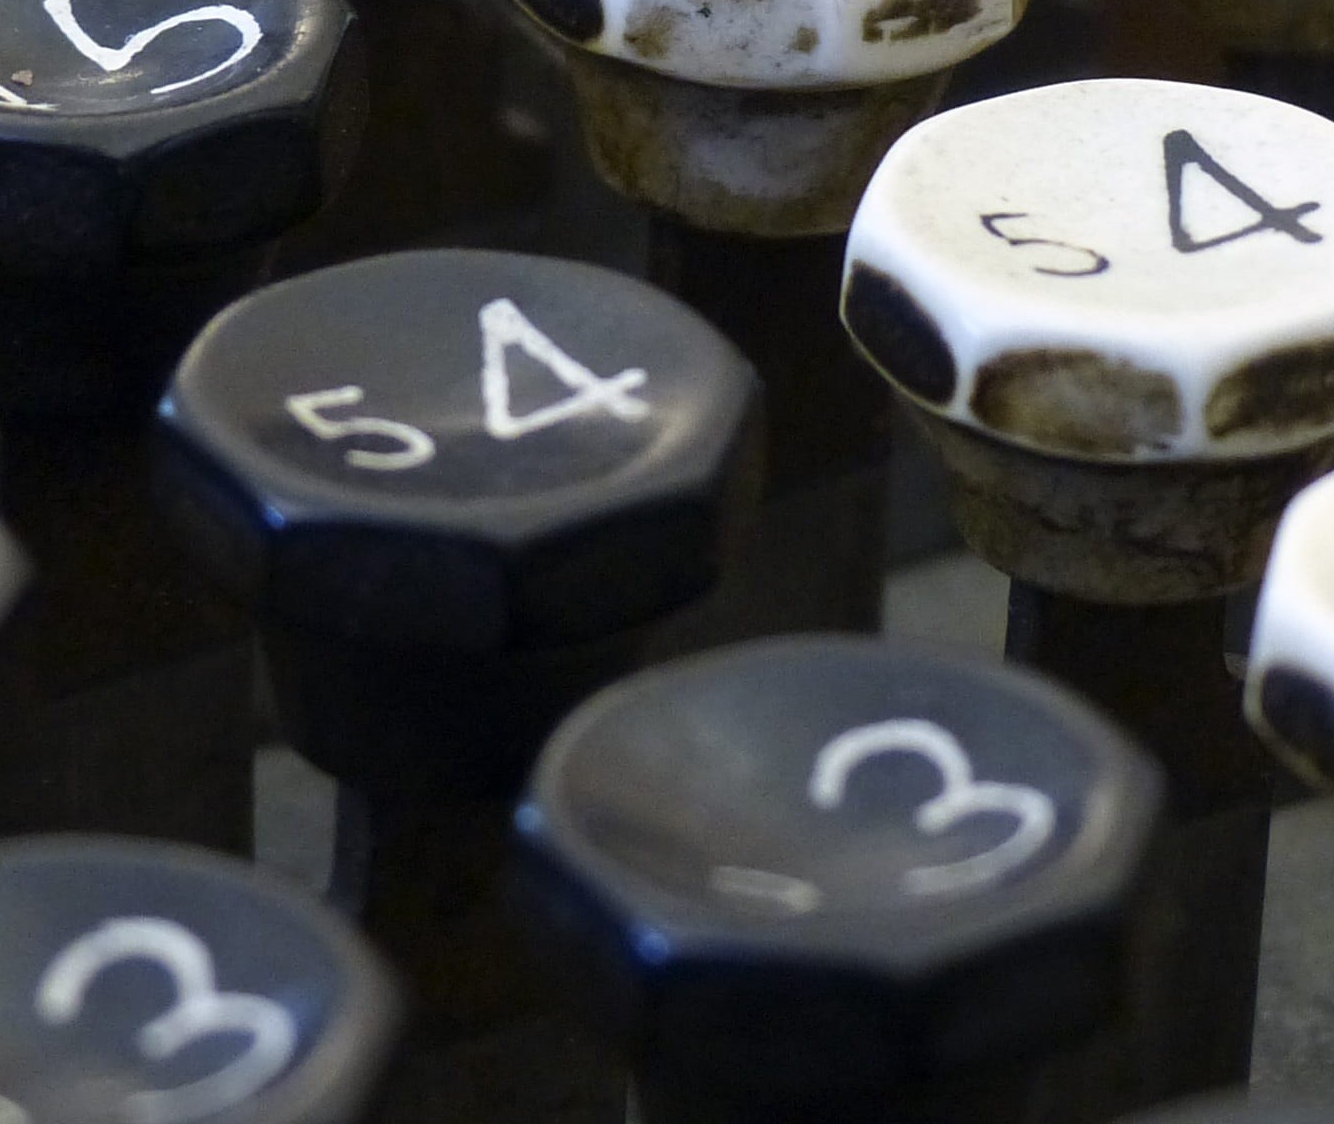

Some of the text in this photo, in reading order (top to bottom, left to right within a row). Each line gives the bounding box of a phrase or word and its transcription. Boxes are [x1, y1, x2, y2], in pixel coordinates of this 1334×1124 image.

[979, 128, 1323, 278] 5 4
[285, 297, 651, 472] 5 4
[810, 718, 1057, 896] 3
[33, 916, 297, 1124] 3
